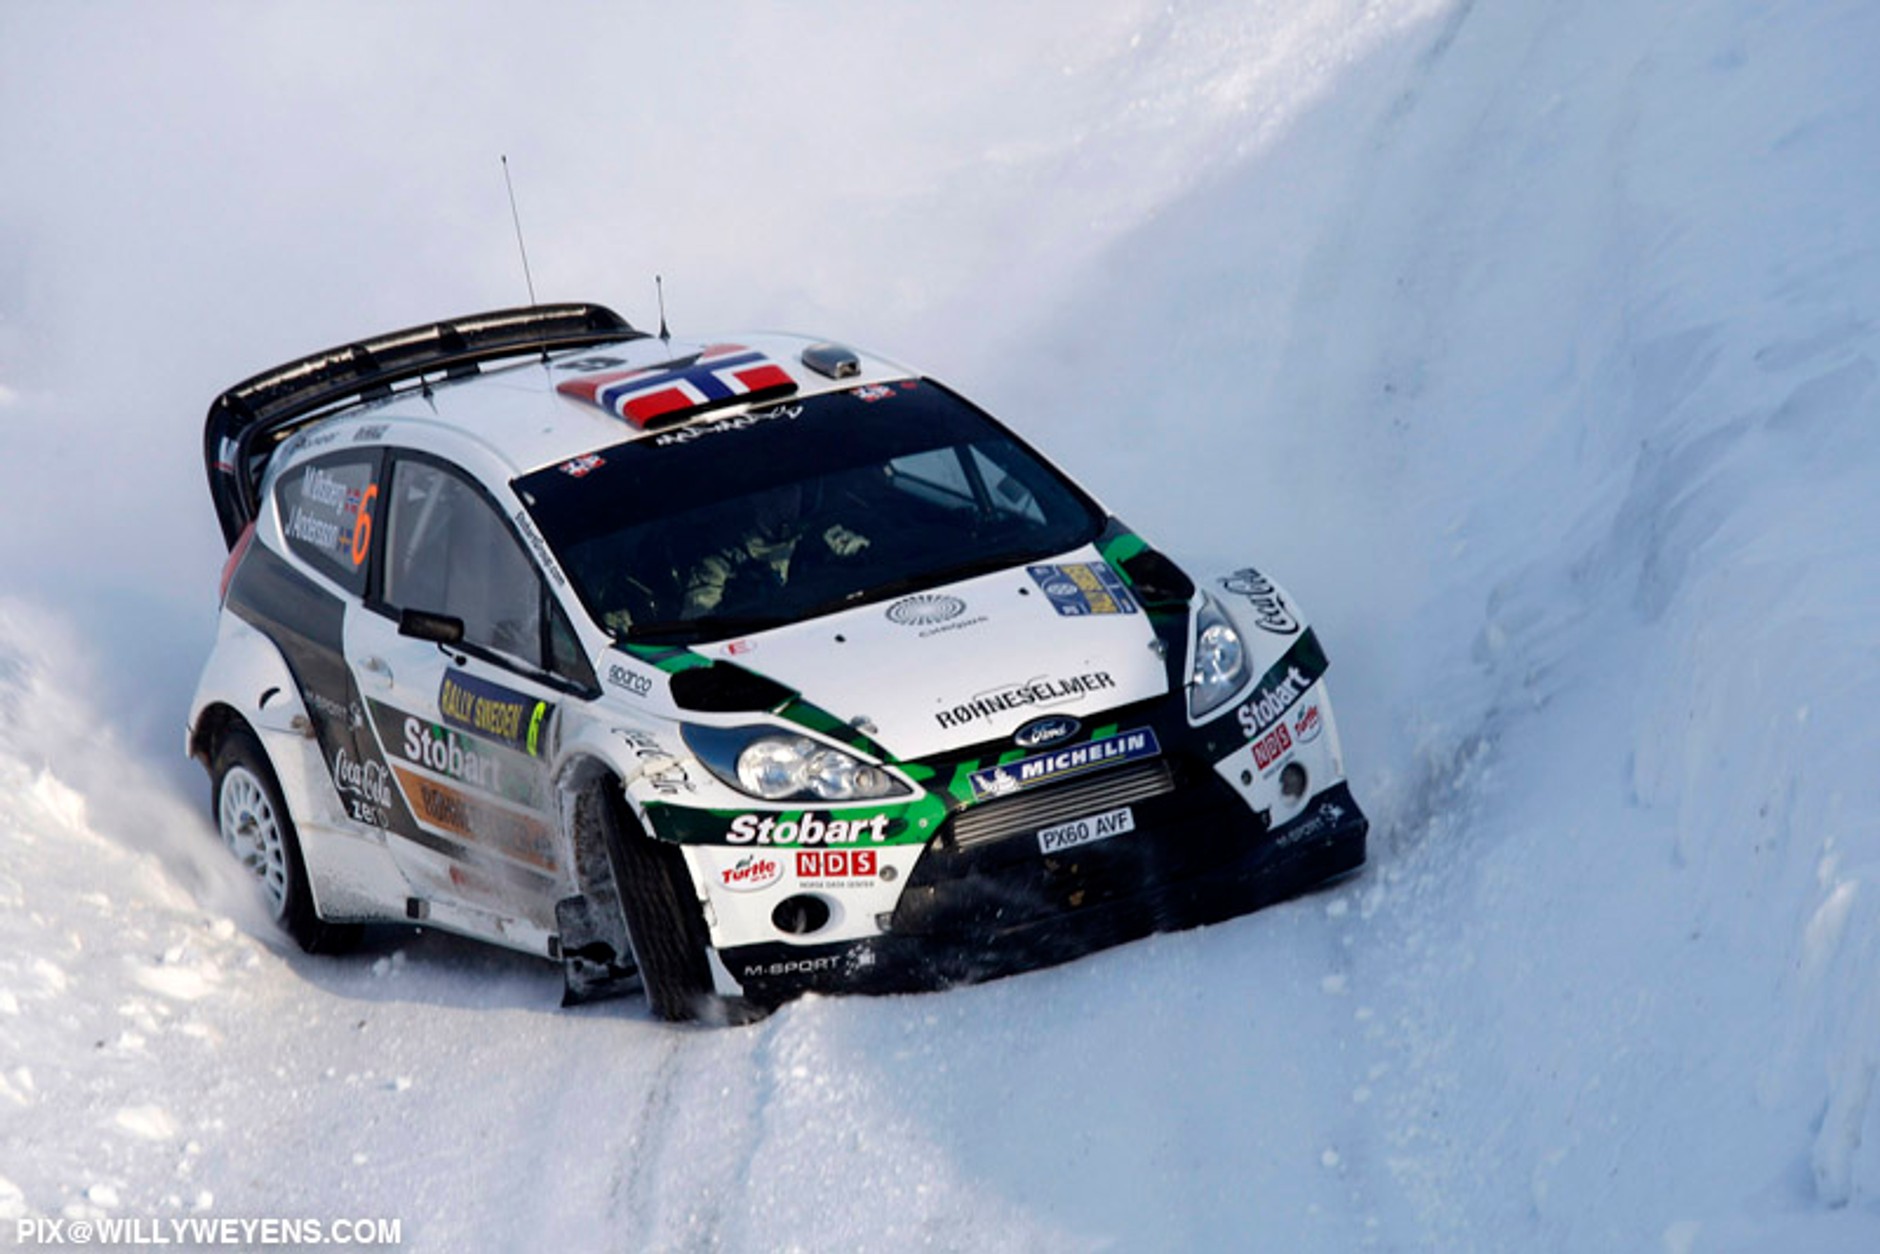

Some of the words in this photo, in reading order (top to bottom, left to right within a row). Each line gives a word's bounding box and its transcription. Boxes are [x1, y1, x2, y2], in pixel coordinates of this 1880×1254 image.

[352, 483, 378, 566] 6
[609, 664, 652, 697] sparco
[442, 678, 475, 723] RALLY
[474, 696, 523, 739] SWEDEN
[935, 672, 1116, 729] RØHNESELMER
[1238, 666, 1310, 739] Stobart
[1031, 726, 1067, 744] Ford
[404, 717, 500, 793] Stobart
[1022, 734, 1145, 779] MICHELIN
[726, 814, 889, 843] Stobart
[1043, 823, 1089, 849] PX60
[1096, 811, 1130, 836] AVF
[721, 859, 776, 884] Turtle
[799, 851, 873, 875] NDS
[745, 955, 839, 977] M-SPORT
